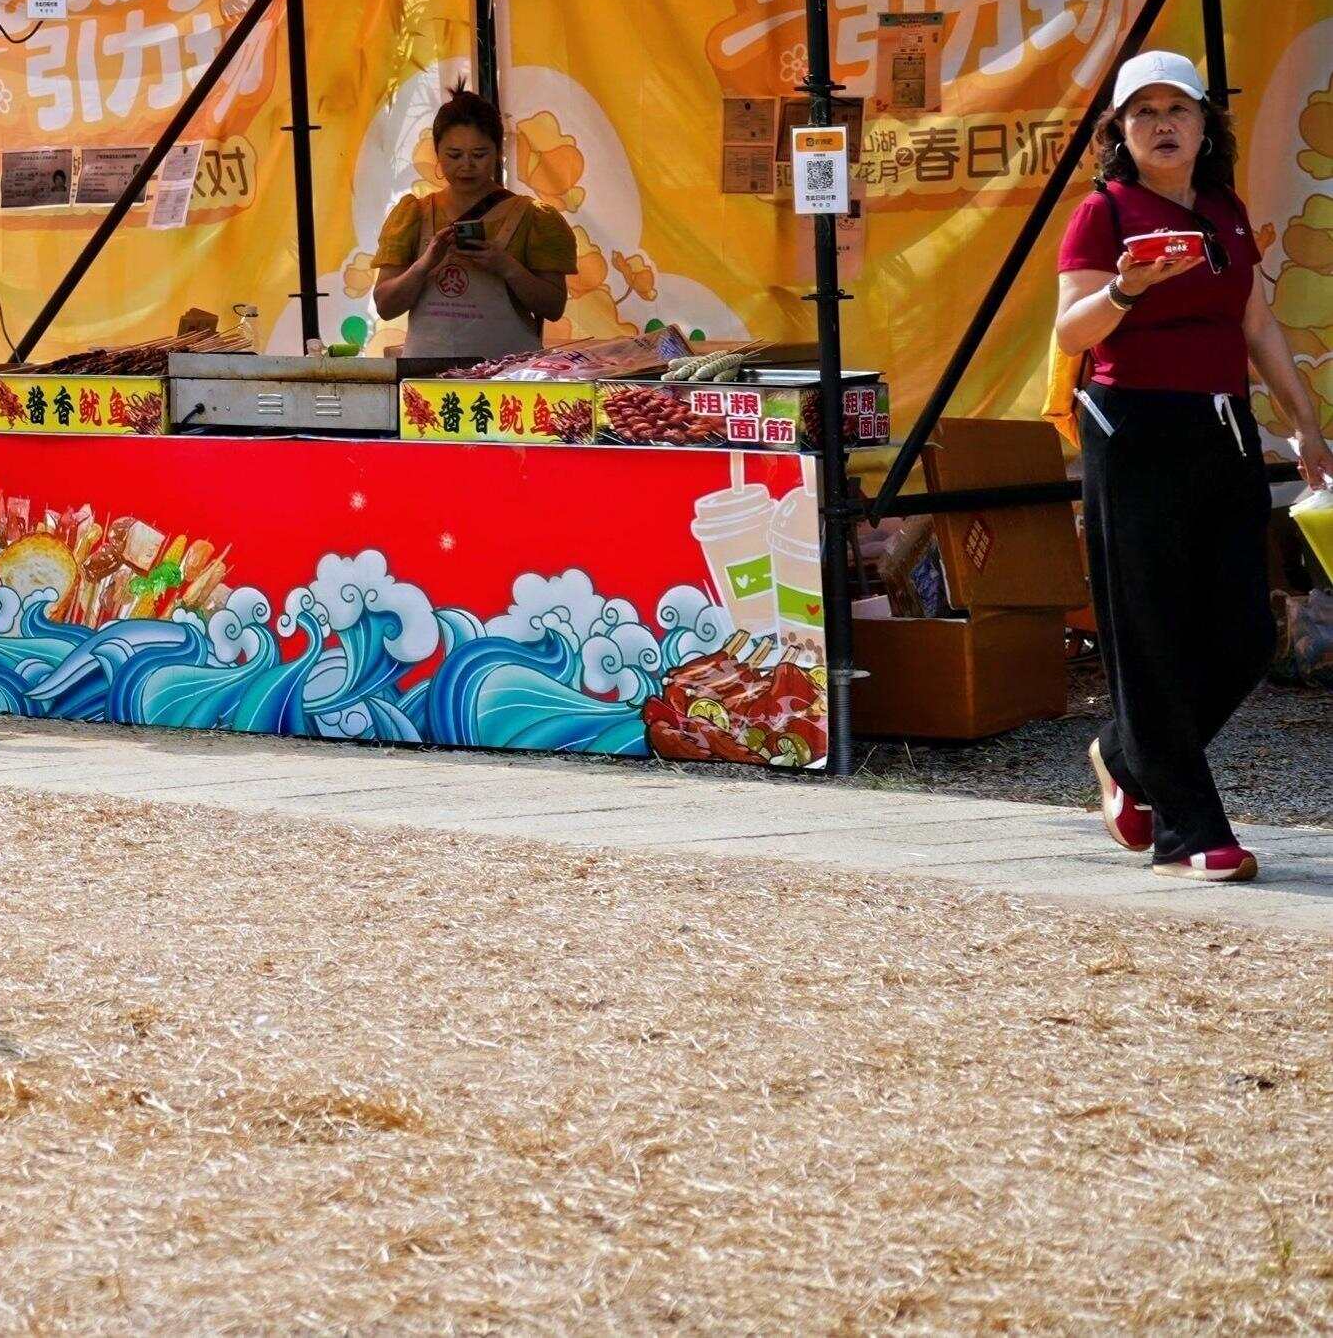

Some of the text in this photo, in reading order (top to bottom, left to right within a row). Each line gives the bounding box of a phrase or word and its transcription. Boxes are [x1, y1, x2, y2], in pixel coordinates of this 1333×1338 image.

[25, 9, 273, 132] 引力场
[26, 384, 130, 428] 酱香鱿鱼
[438, 390, 554, 436] 酱香鱿鱼
[692, 390, 761, 415] 粗粮
[843, 390, 876, 415] 粗粮
[727, 418, 796, 442] 面筋
[859, 414, 889, 439] 面筋
